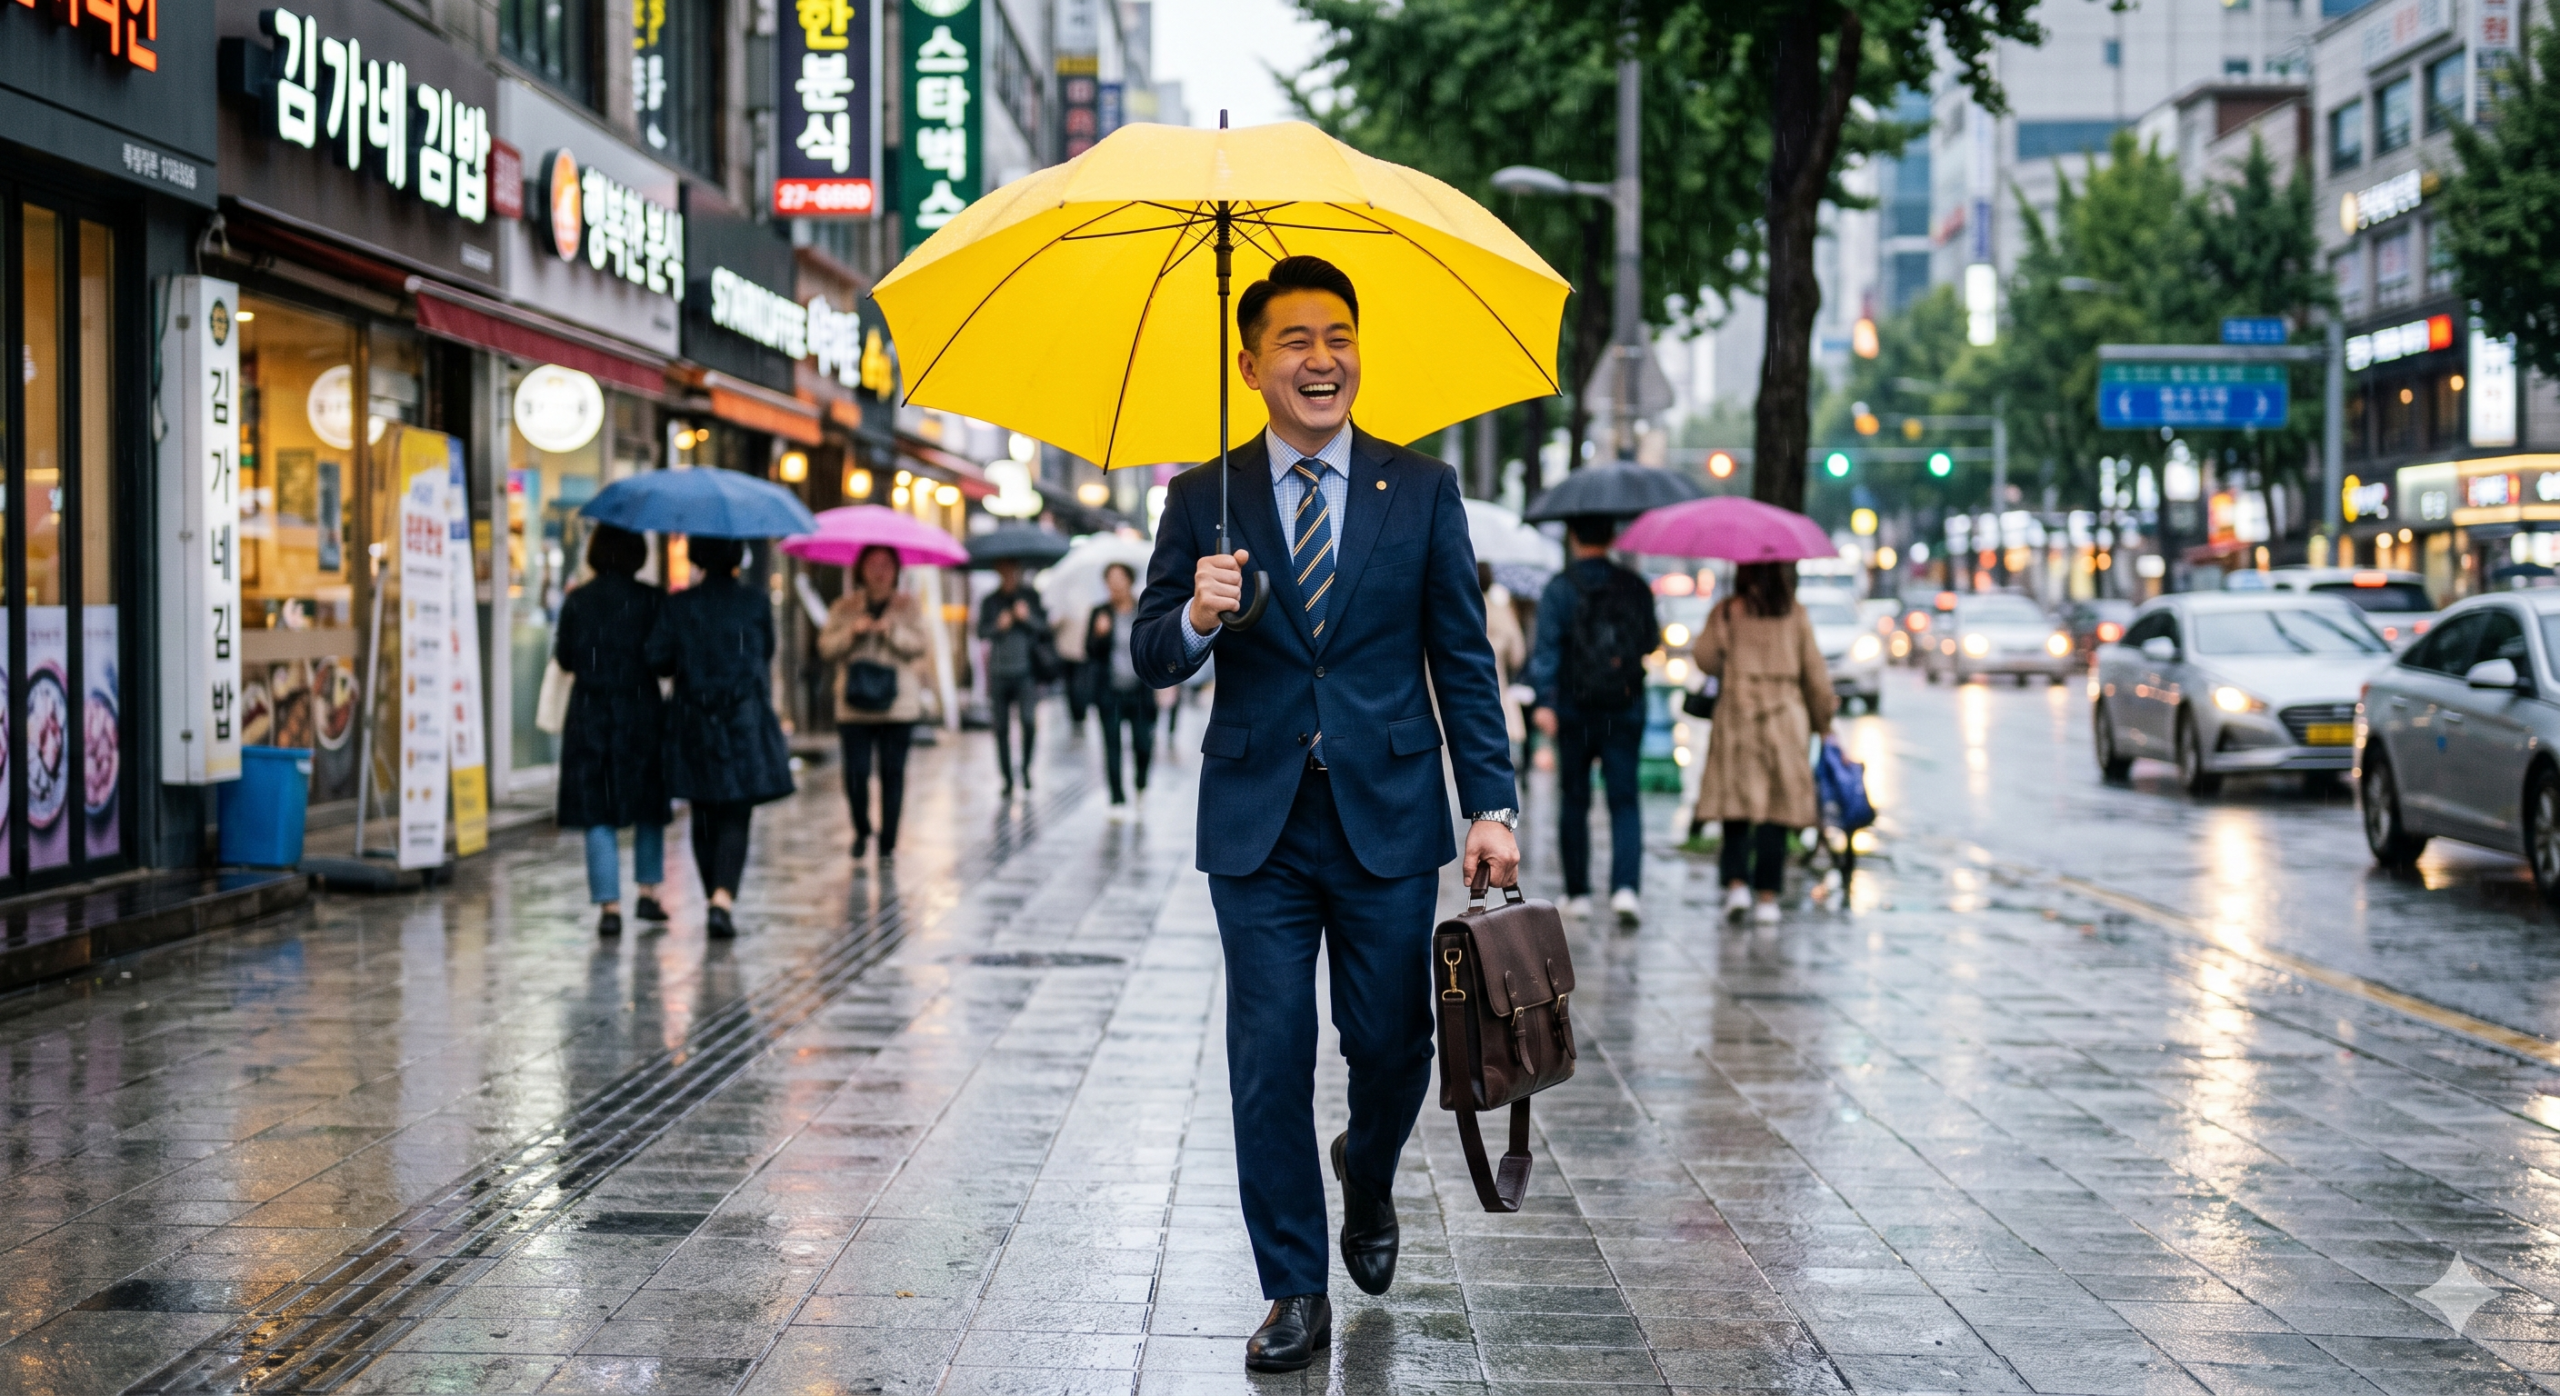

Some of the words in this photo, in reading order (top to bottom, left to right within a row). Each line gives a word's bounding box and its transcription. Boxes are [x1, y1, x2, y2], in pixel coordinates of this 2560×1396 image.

[275, 7, 407, 190] 김가네
[417, 83, 491, 224] 김밥
[915, 25, 971, 229] 스타벅스
[211, 367, 233, 740] 김가네김밥
